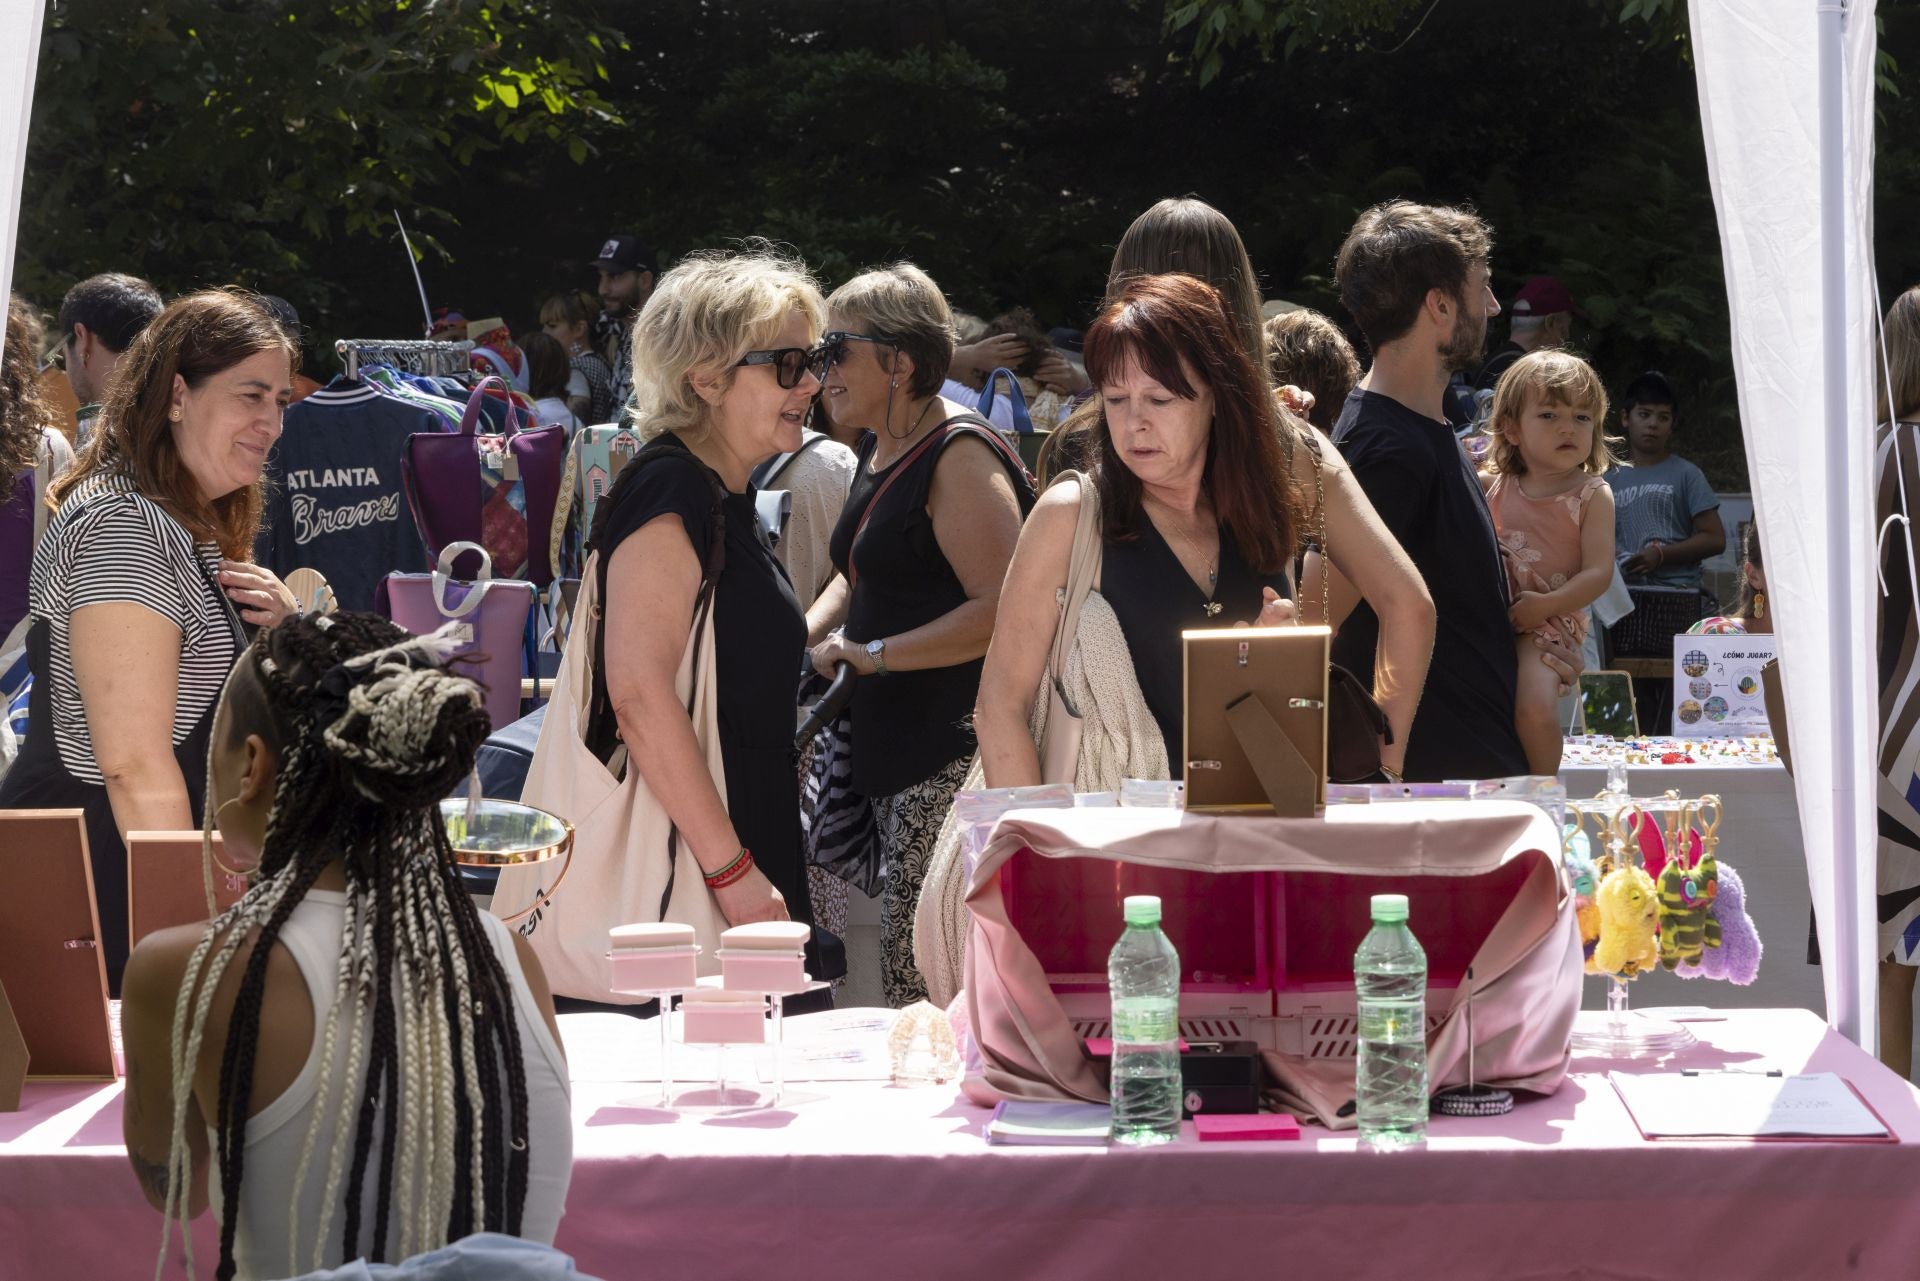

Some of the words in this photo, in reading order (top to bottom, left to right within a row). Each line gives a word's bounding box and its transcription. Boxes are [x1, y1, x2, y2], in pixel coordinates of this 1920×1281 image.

[287, 467, 380, 491] ATLANTA
[291, 491, 400, 545] Braves
[1722, 650, 1745, 659] ¿CÓMO
